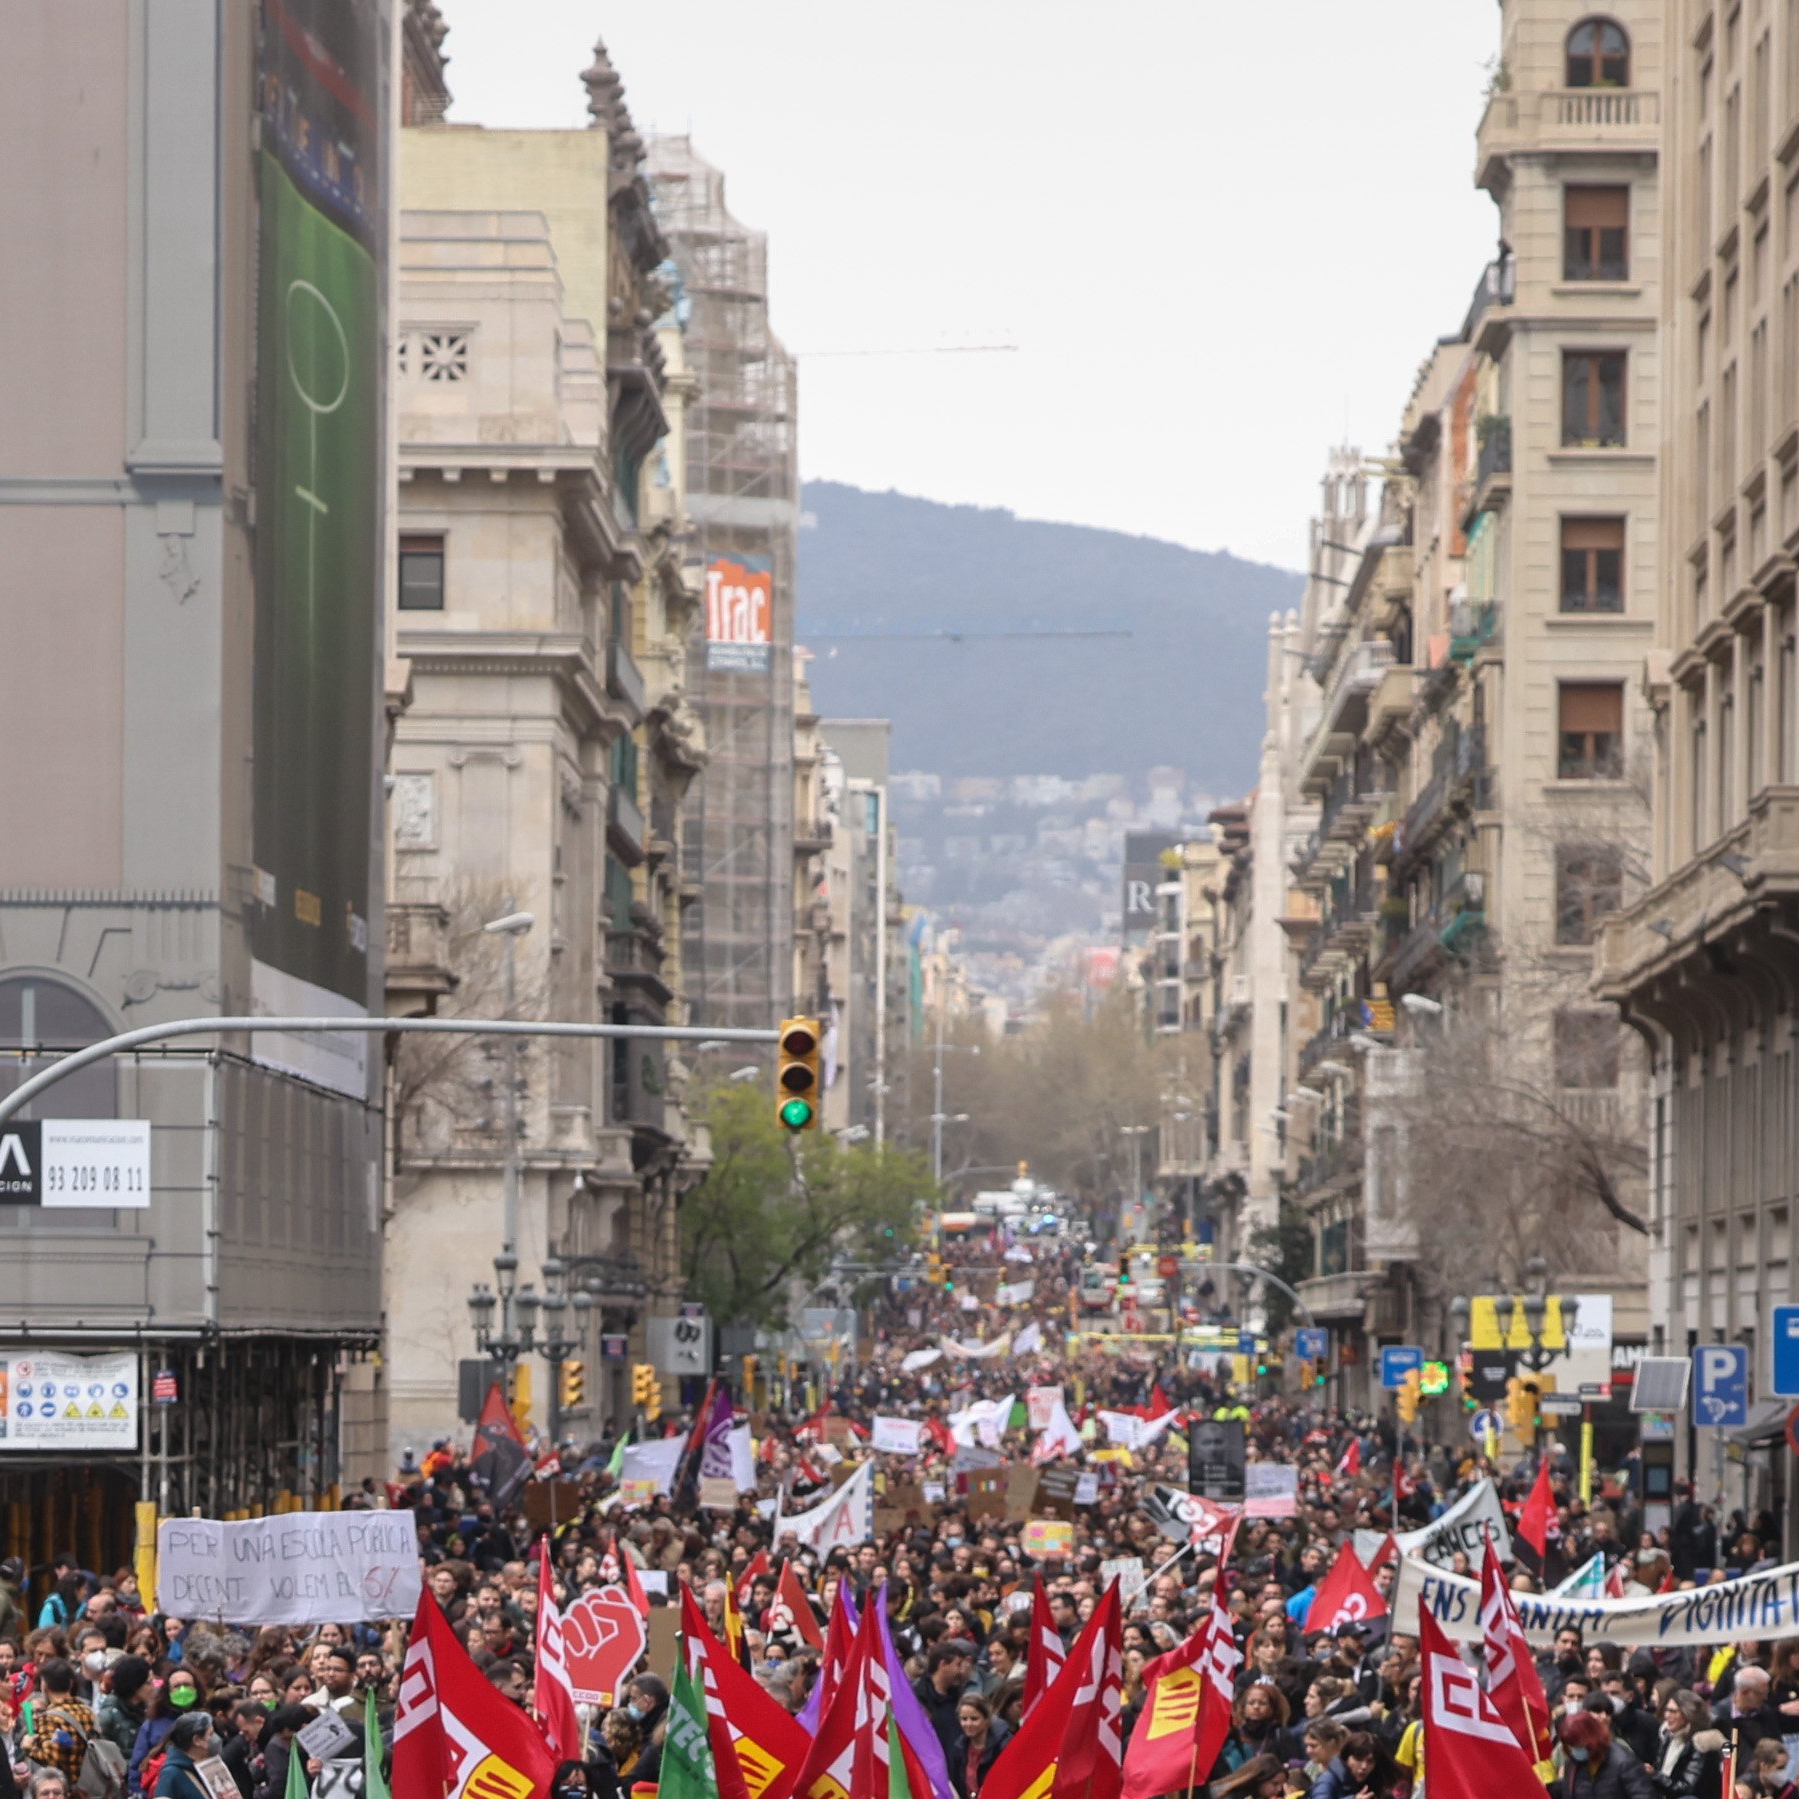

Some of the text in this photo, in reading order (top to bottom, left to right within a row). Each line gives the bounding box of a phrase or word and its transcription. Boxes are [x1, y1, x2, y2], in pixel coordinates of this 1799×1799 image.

[707, 570, 767, 643] Trac
[48, 1165, 143, 1192] 93 209 08 11
[1703, 1350, 1738, 1392] P
[168, 1530, 218, 1560] PER
[232, 1536, 276, 1564] UNA
